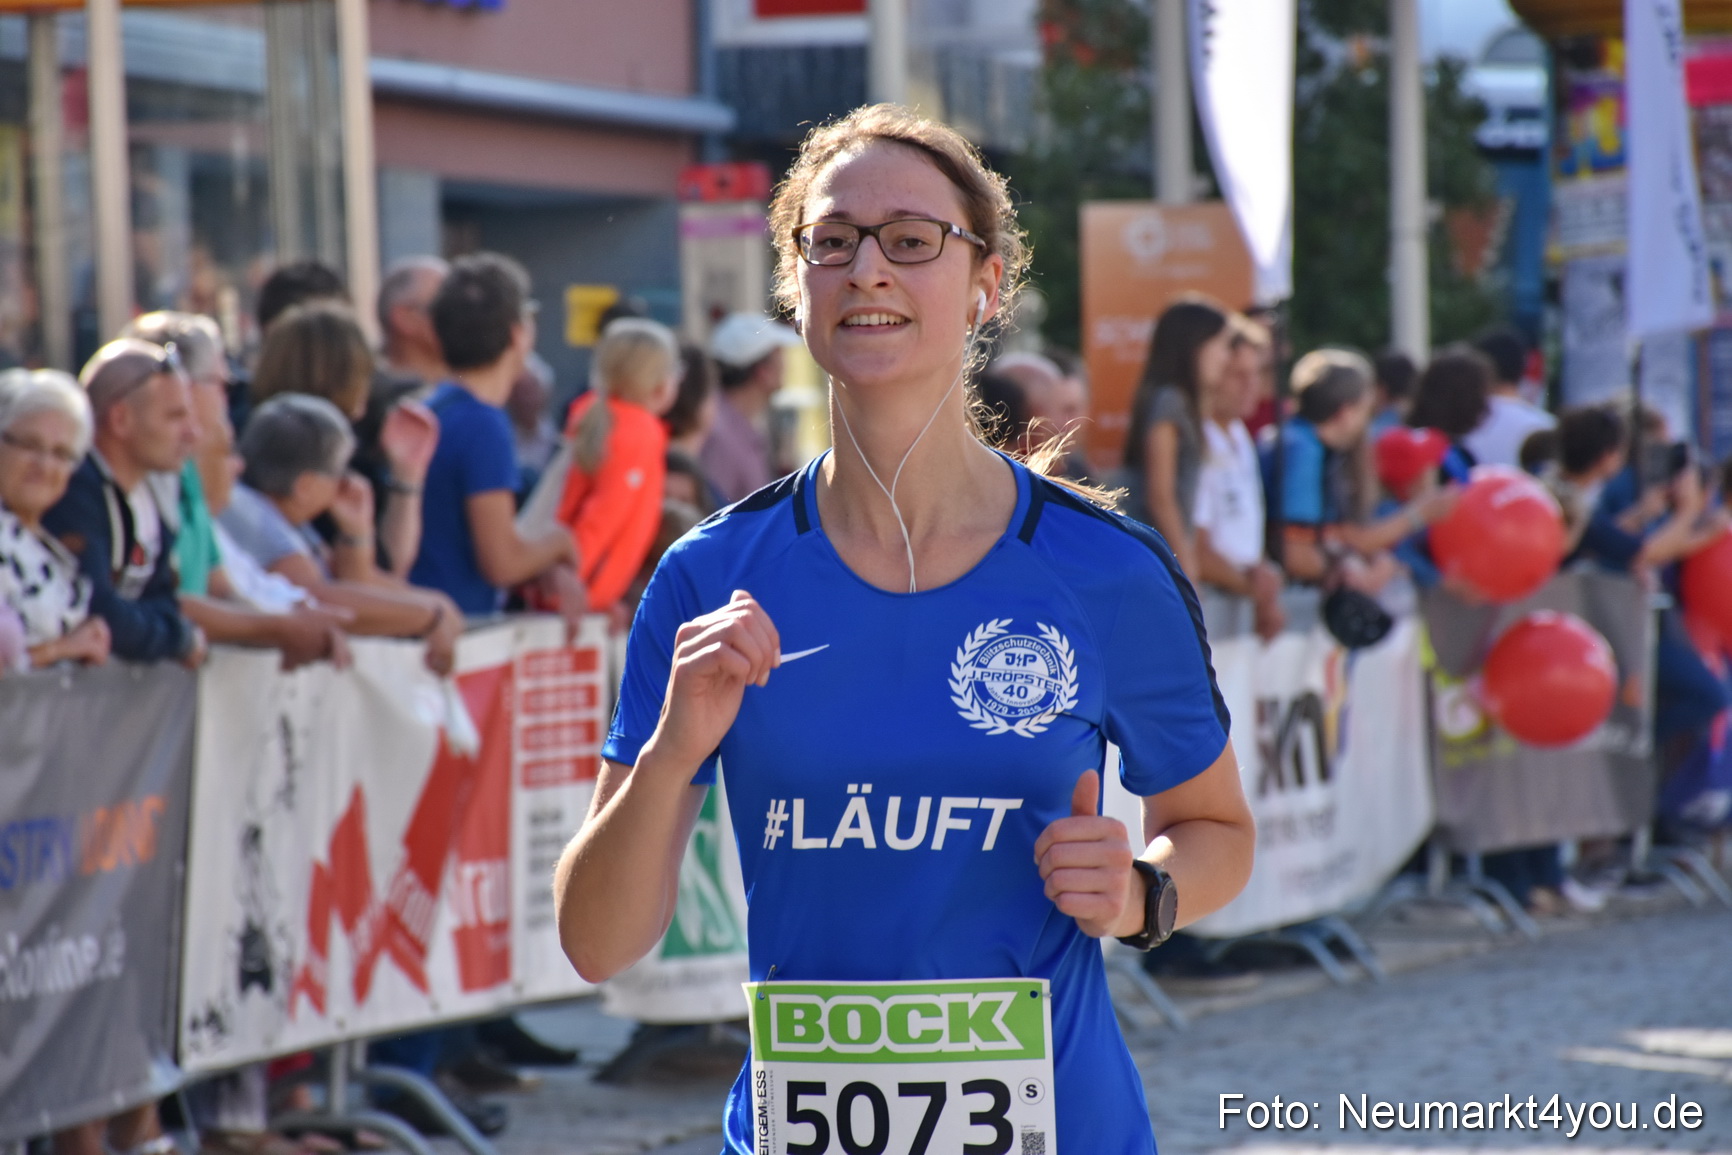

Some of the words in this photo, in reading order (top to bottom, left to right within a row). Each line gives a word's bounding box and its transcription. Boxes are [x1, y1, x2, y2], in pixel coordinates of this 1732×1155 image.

[979, 637, 1058, 676] Blitzschutztechnik
[988, 686, 1005, 701] Jahre
[1006, 693, 1042, 706] Innovation
[1003, 684, 1028, 699] 40
[985, 698, 1009, 715] 1979
[763, 783, 1024, 851] #LÄUFT
[774, 1000, 1012, 1046] BOCK
[1025, 1083, 1038, 1099] S
[786, 1078, 1014, 1155] 5073
